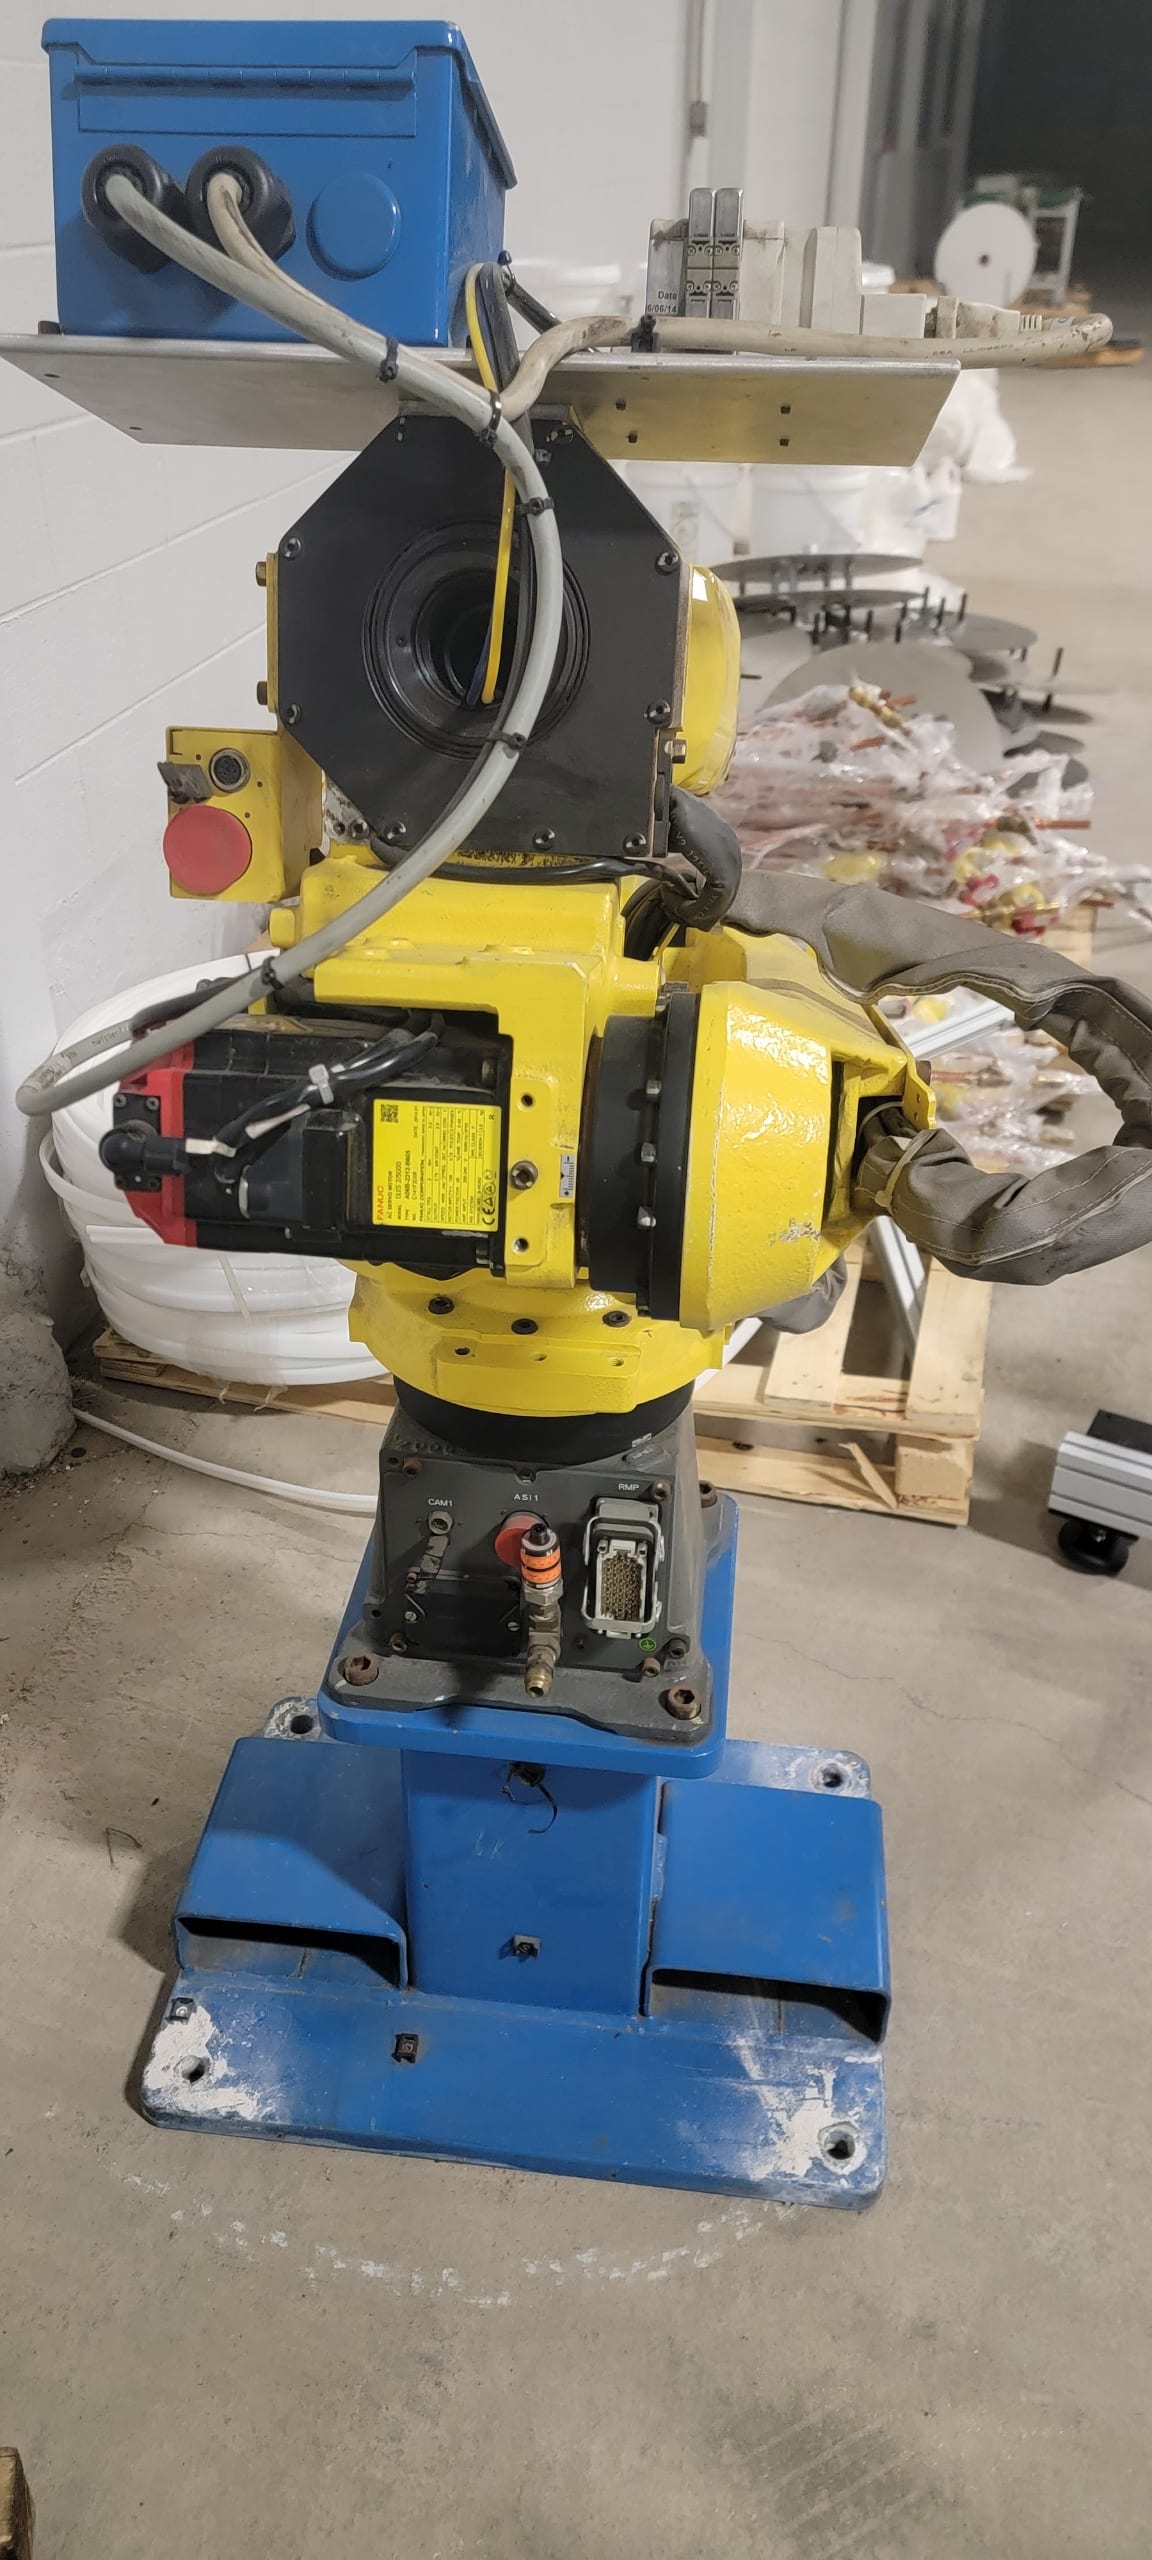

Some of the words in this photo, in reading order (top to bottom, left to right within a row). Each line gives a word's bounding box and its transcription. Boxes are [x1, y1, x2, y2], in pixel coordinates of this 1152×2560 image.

[658, 290, 678, 300] Date
[618, 1483, 640, 1491] RMP
[427, 1498, 453, 1507] CAM1
